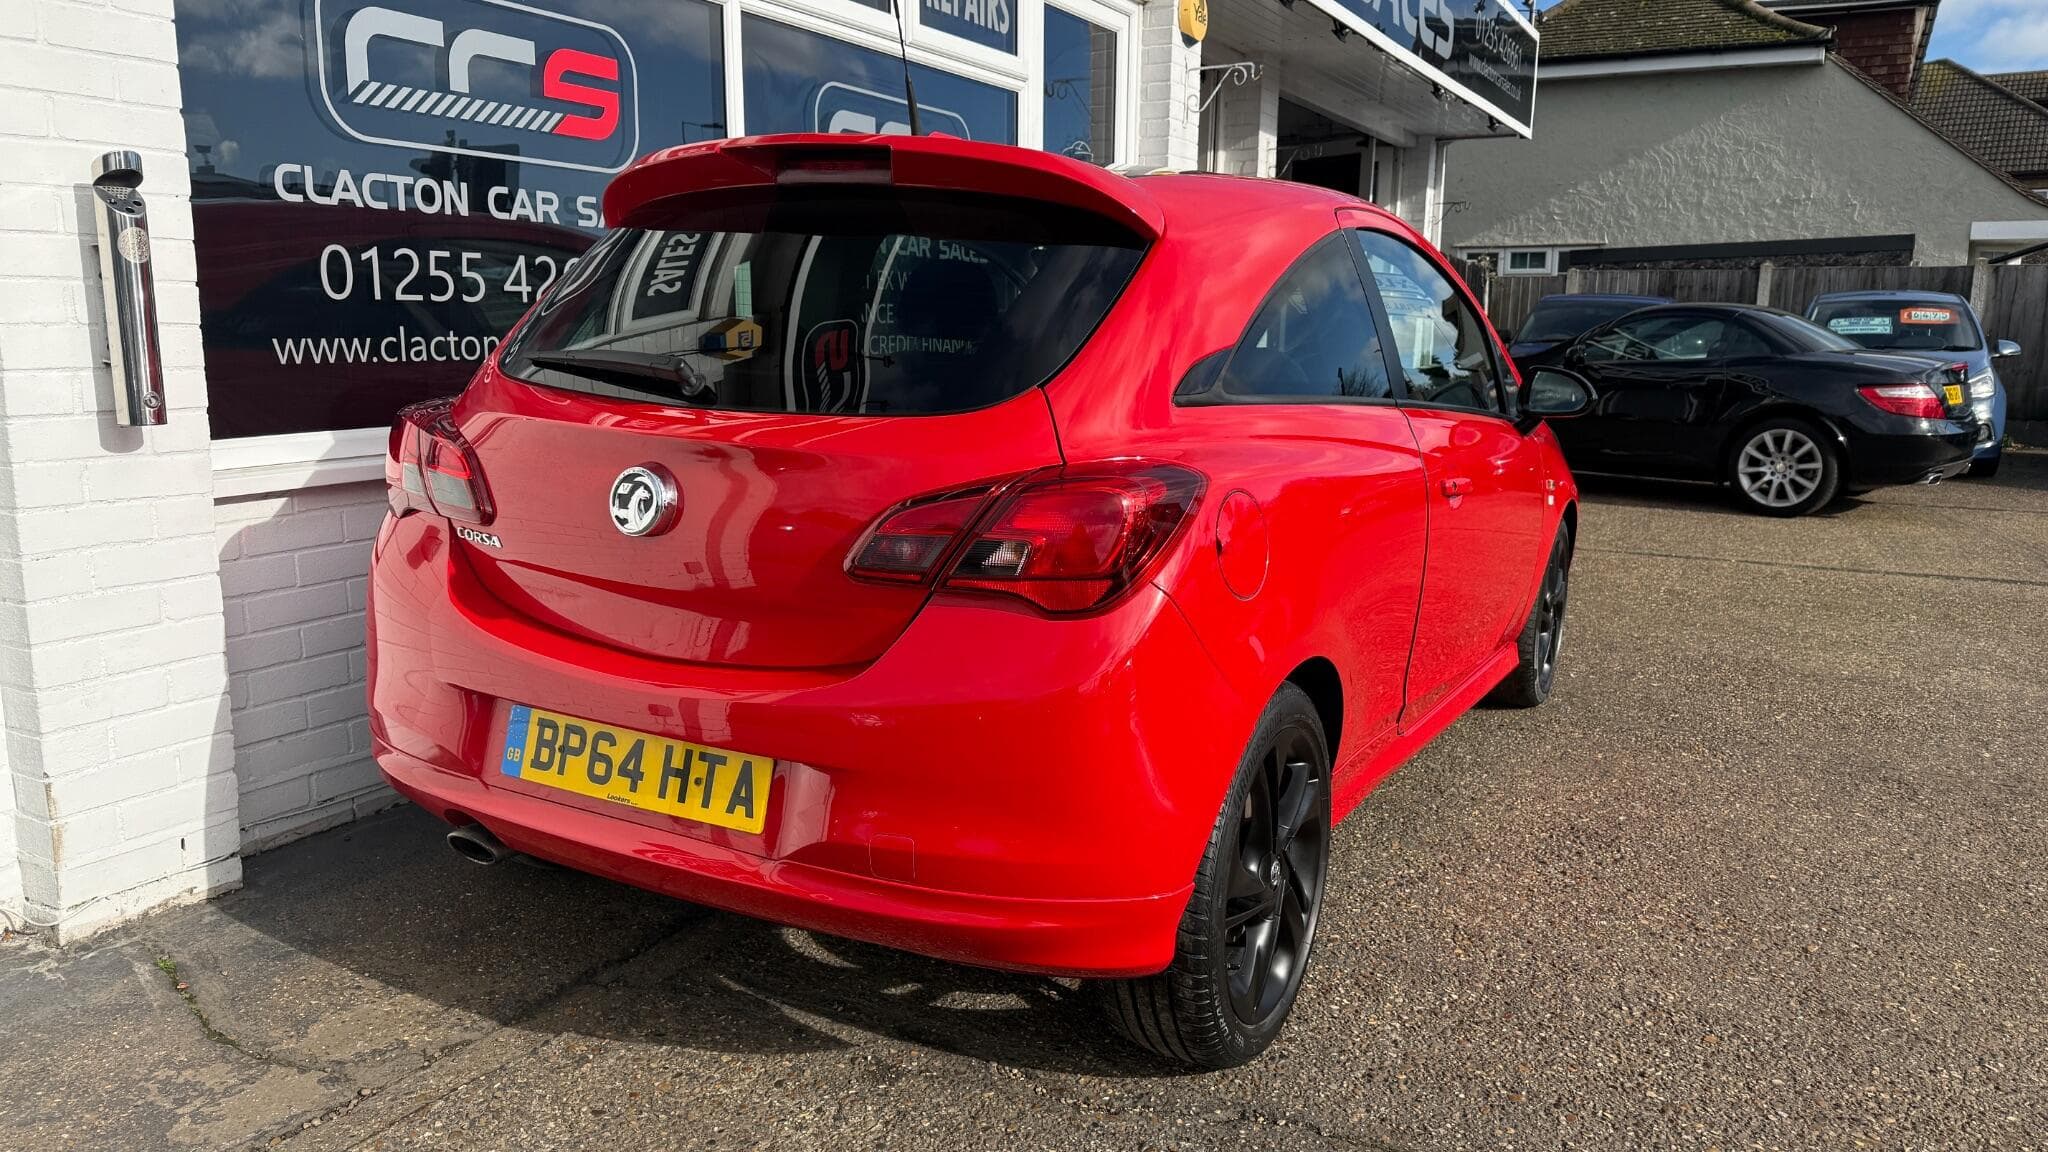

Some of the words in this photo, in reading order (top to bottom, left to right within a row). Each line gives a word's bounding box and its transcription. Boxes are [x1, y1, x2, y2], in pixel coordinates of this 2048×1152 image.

[1475, 10, 1499, 53] 01255
[273, 163, 469, 217] CLACTON
[487, 186, 560, 224] CAR
[320, 243, 487, 303] 01255
[457, 526, 502, 549] CORSA
[507, 746, 521, 762] GB
[530, 717, 645, 793] BP64
[658, 745, 755, 820] HTA
[606, 792, 631, 805] Lookers
